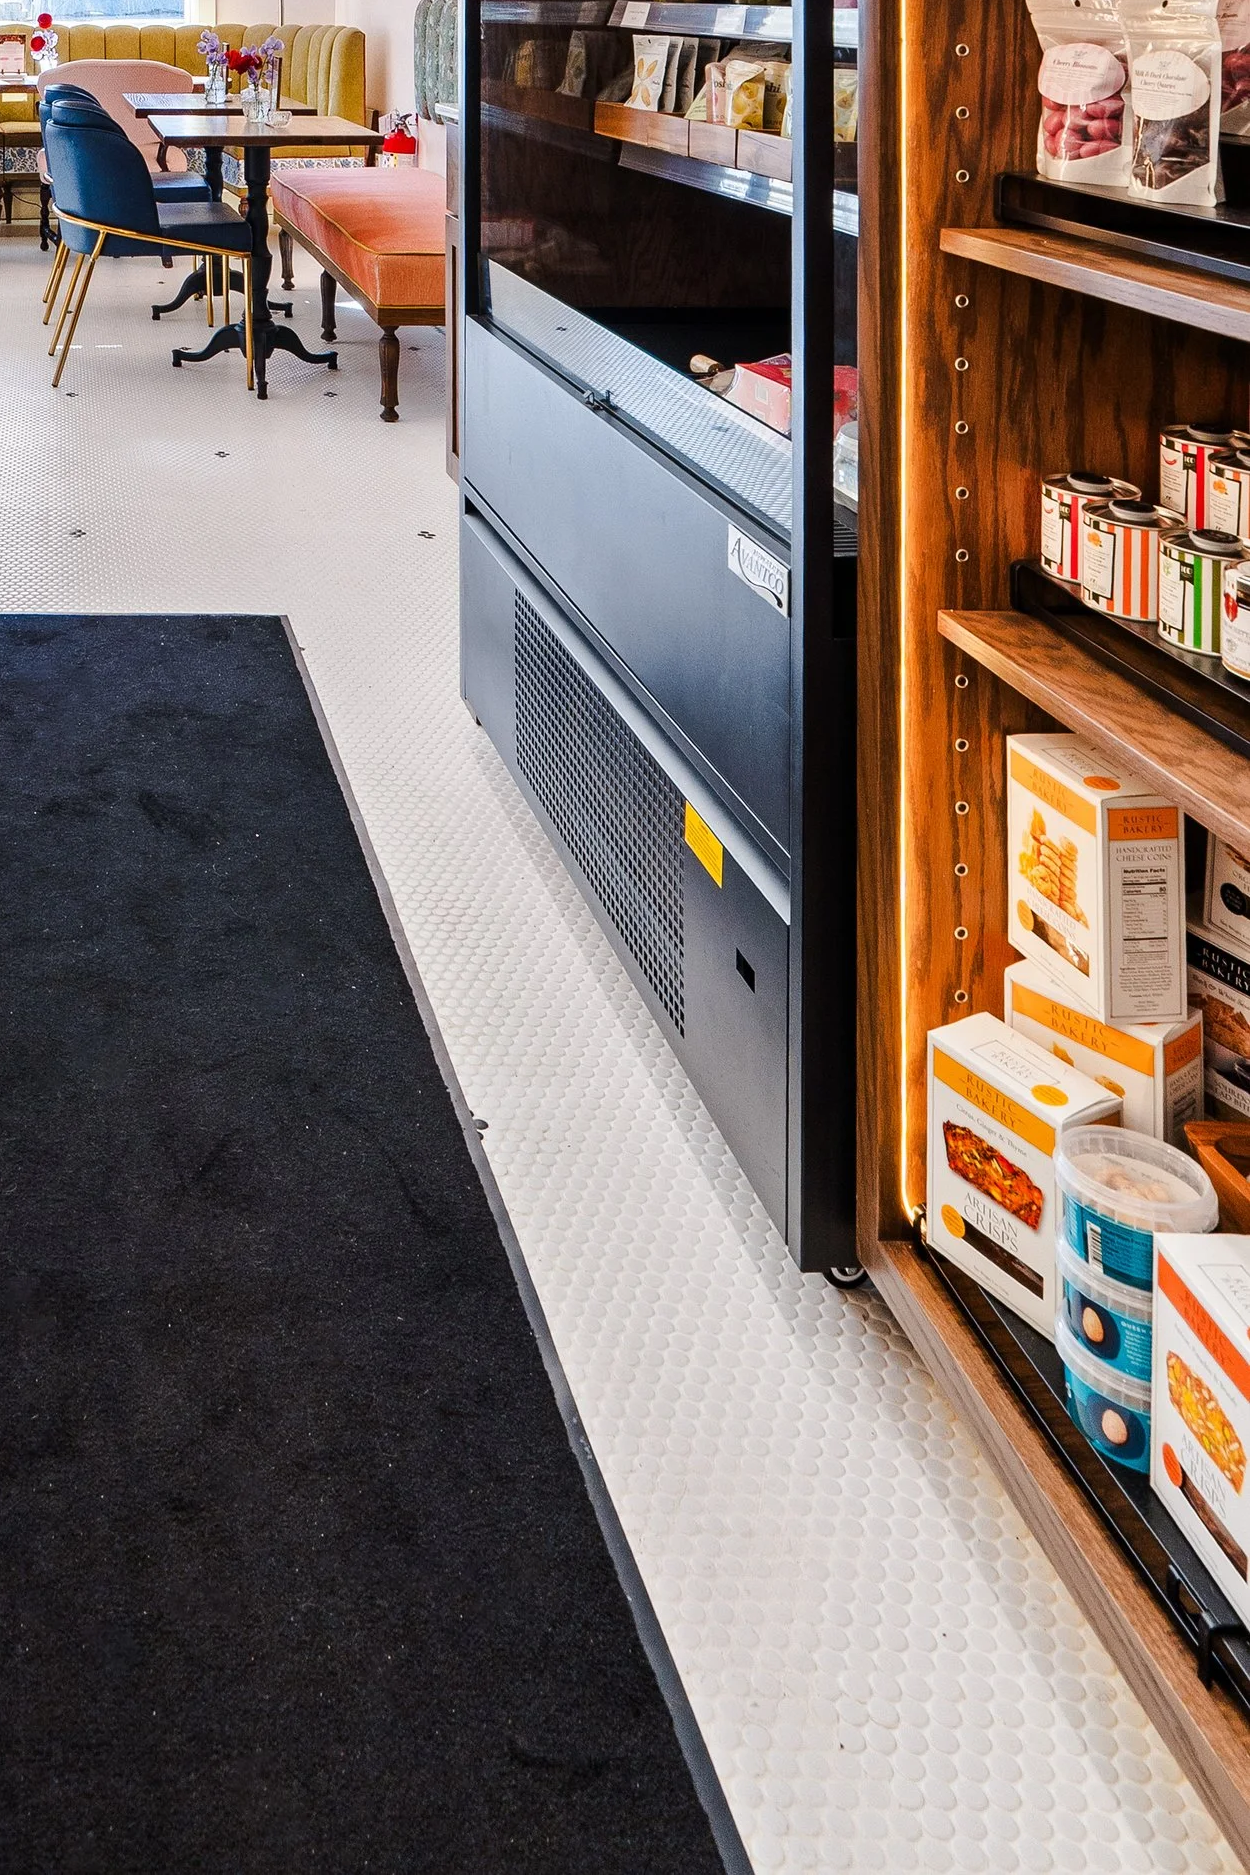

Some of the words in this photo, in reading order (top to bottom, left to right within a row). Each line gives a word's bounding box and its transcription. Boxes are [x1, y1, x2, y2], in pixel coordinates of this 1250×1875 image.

[730, 536, 784, 596] AVANTCO
[1123, 815, 1162, 824] RUSTIC
[1123, 825, 1163, 834] BAKERY
[1116, 845, 1172, 854] HANDCRAFTED
[1116, 854, 1145, 862] CHEESE
[1147, 853, 1172, 861] COINS
[1202, 958, 1250, 992] BAKERY
[1203, 947, 1250, 979] RUSTIC
[1051, 1004, 1104, 1037] RUSTIC
[1051, 1017, 1108, 1052] BAKERY
[966, 1086, 1016, 1128] BAKERY
[967, 1073, 1017, 1115] RUSTIC
[1008, 1139, 1028, 1157] Thyme
[964, 1204, 1019, 1253] CRISPS
[965, 1192, 1018, 1238] ARTISAN
